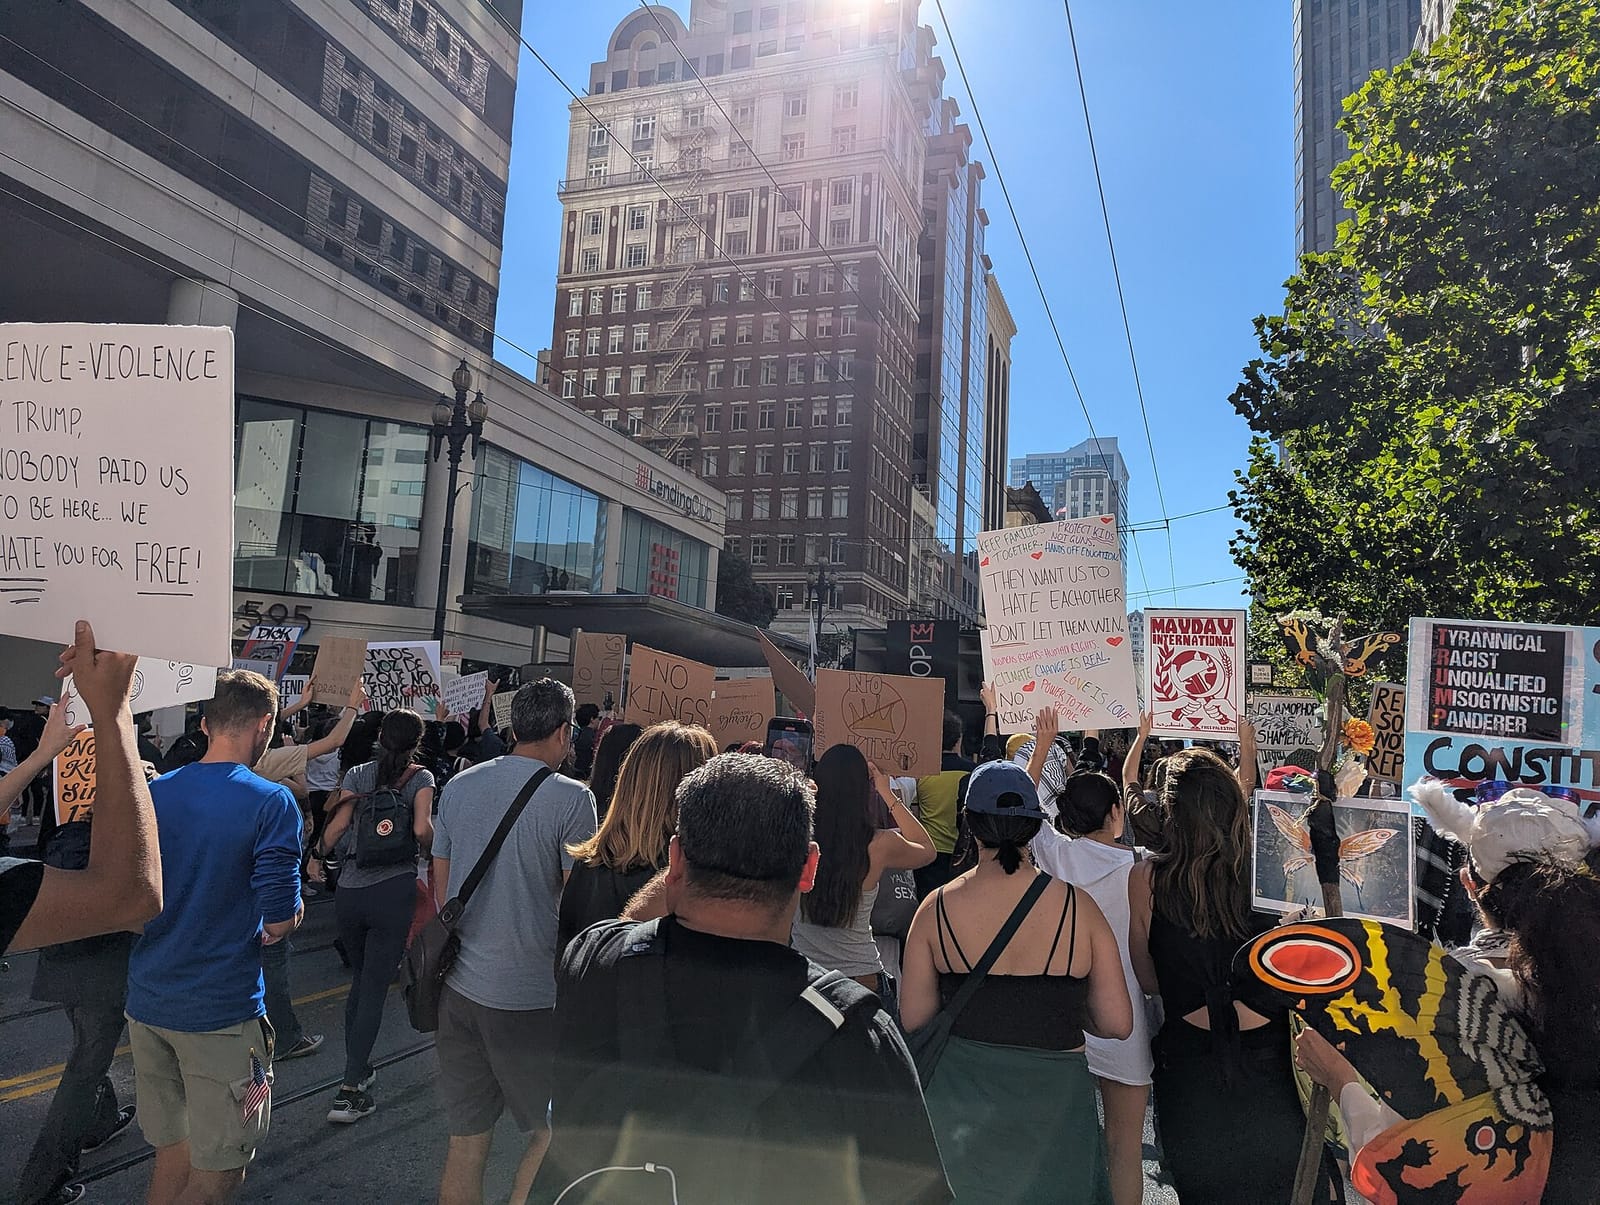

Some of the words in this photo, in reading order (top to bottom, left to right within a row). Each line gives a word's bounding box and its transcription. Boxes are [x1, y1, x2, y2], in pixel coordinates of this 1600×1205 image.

[12, 400, 82, 439] TRUMP,
[99, 456, 147, 486] PAID
[160, 465, 189, 496] US
[648, 470, 712, 521] LendingClub
[0, 494, 19, 520] O
[30, 496, 54, 521] BE
[121, 501, 149, 525] WE
[978, 535, 1001, 555] KEEP
[1004, 524, 1046, 544] FAMILIES
[1051, 531, 1068, 541] NOT
[1070, 534, 1096, 547] GUNS.
[1057, 521, 1090, 536] PROTECT
[1091, 526, 1115, 541] KIDS
[992, 540, 1043, 562] TOGETHER.
[1045, 541, 1066, 554] HANDS
[1067, 545, 1080, 554] OFF
[54, 542, 84, 566] YOU
[92, 546, 123, 570] FOR
[135, 542, 201, 585] FREE!
[986, 568, 1025, 593] THEY
[1029, 566, 1064, 586] WANT
[1068, 566, 1087, 583] US
[1088, 566, 1110, 578] TO
[1001, 591, 1041, 617] HATE
[1050, 588, 1123, 610] EACHOTHER
[990, 622, 1027, 645] DONT
[1032, 621, 1052, 640] LET
[1058, 620, 1092, 638] THEM
[1092, 616, 1125, 633] WIN.
[1152, 634, 1235, 647] INTERNATIONAL
[1437, 628, 1546, 653] TYRANNICAL
[599, 635, 624, 692] KINGS
[1435, 647, 1500, 669] RACIST
[411, 671, 432, 686] NO
[576, 667, 593, 694] NO
[652, 659, 689, 691] NO
[848, 674, 883, 695] NO
[994, 666, 1033, 688] CLIMATE
[1034, 660, 1066, 678] CHANGE
[1068, 658, 1082, 669] IS
[1434, 668, 1546, 693] UNQUALIFIED
[1000, 691, 1024, 708] NO
[1040, 679, 1065, 700] POWER
[1063, 671, 1092, 693] LOVE
[1090, 686, 1109, 705] IS
[1434, 687, 1558, 715] MISOGYNISTIC
[628, 682, 711, 725] KINGS
[1000, 708, 1035, 725] KINGS
[1432, 708, 1528, 733] PANDERER
[847, 735, 918, 768] KINGS
